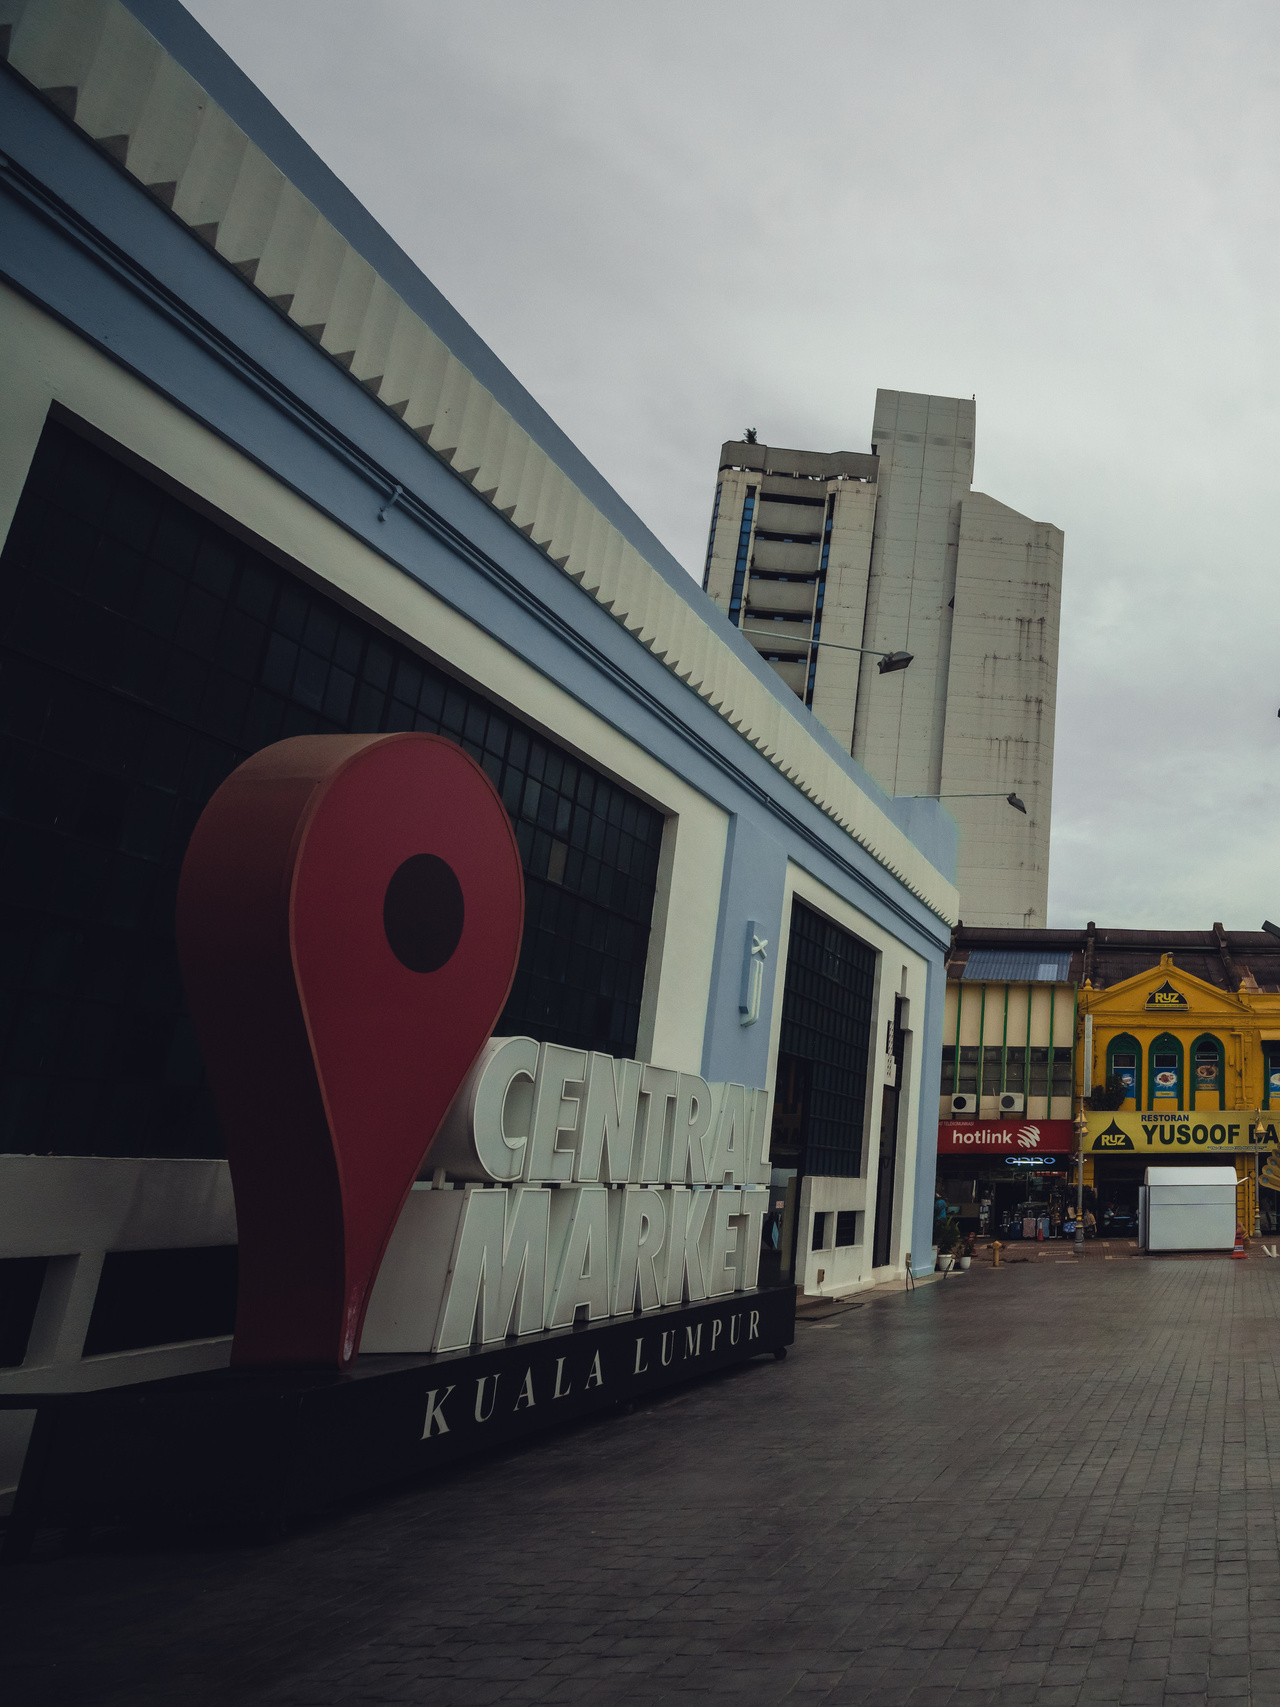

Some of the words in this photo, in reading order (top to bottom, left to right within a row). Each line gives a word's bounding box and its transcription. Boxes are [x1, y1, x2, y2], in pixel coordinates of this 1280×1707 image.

[474, 1036, 773, 1185] CENTRAL
[953, 1129, 1013, 1144] hotlink
[1142, 1124, 1240, 1145] YUSOOF
[437, 1187, 769, 1353] MARKET
[419, 1349, 604, 1441] KUALA
[632, 1310, 761, 1375] LUMPUR
